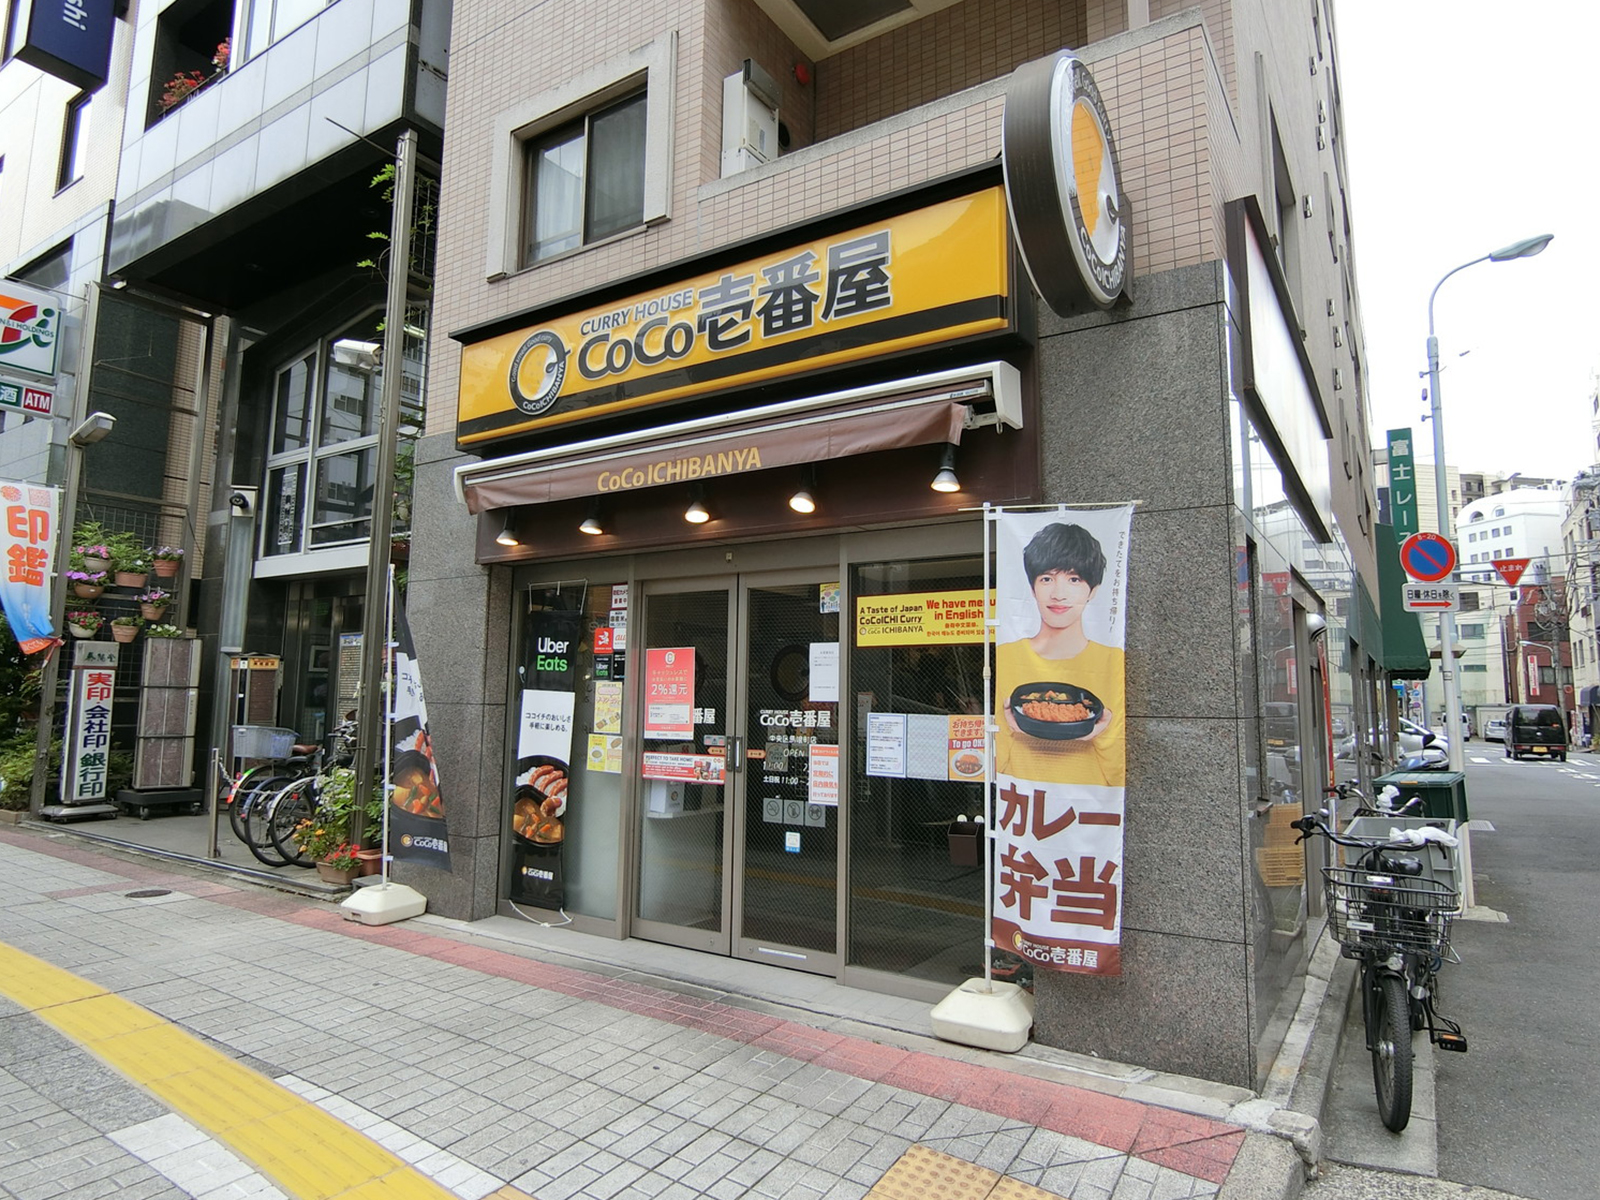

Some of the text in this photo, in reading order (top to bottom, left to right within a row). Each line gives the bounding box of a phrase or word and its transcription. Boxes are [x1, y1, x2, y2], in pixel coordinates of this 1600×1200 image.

[577, 229, 891, 380] CoCo壱番屋
[580, 289, 693, 336] CURRY HOUSE
[16, 323, 54, 338] HOLDINGS
[25, 391, 50, 411] ATM
[6, 504, 50, 588] 印鑑
[1500, 564, 1524, 573] 止まれ
[866, 606, 889, 614] Taste
[890, 605, 898, 613] of
[900, 605, 923, 613] Japan
[926, 598, 996, 609] We have meu
[859, 615, 922, 625] CoCoICHI Curry
[934, 611, 943, 620] in
[882, 625, 923, 634] ICHIBANYA
[537, 637, 570, 654] Uber
[536, 655, 568, 672] Eats
[651, 684, 688, 696] 2%還元
[760, 710, 831, 728] CoCo壱番屋
[952, 740, 961, 749] To
[962, 740, 972, 749] go
[783, 748, 805, 757] OPEN
[777, 776, 799, 785] 11:00
[998, 782, 1122, 840] カレー
[999, 843, 1120, 931] 弁当
[1022, 944, 1098, 968] CoCo壱番屋
